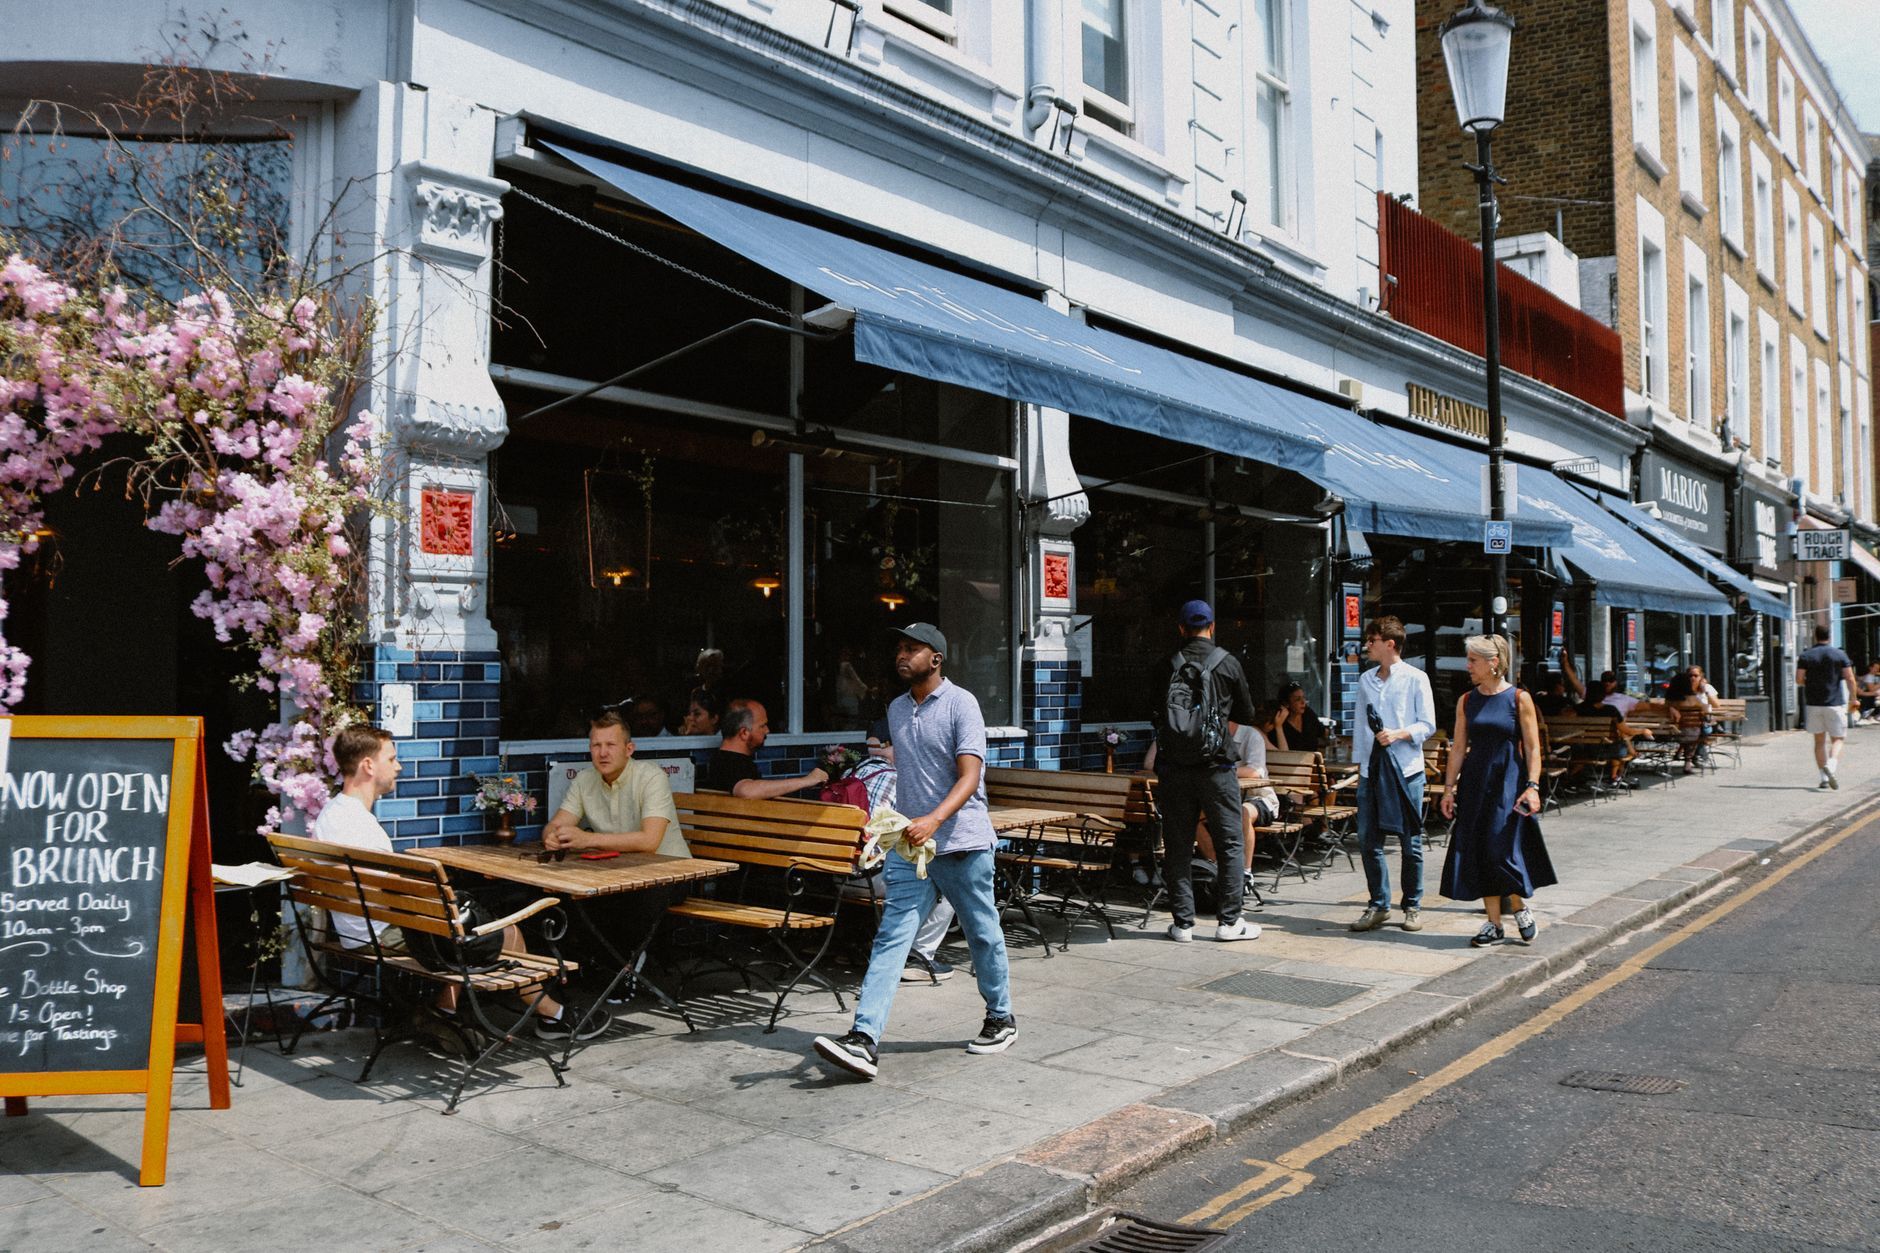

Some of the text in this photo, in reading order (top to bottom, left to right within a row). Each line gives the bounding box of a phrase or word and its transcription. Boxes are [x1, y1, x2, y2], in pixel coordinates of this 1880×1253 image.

[1661, 467, 1708, 515] MARIOS
[1804, 532, 1842, 545] ROUGH
[1805, 546, 1842, 558] TRADE
[2, 770, 168, 814] NOW OPEN
[46, 810, 108, 843] FOR
[12, 846, 157, 887] BRUNCH
[0, 892, 131, 922] Served Daily
[2, 919, 53, 938] 10am
[70, 916, 106, 937] 3pm
[20, 968, 127, 999] Bottle Shop
[19, 1029, 48, 1057] for
[53, 1025, 118, 1051] Tastings
